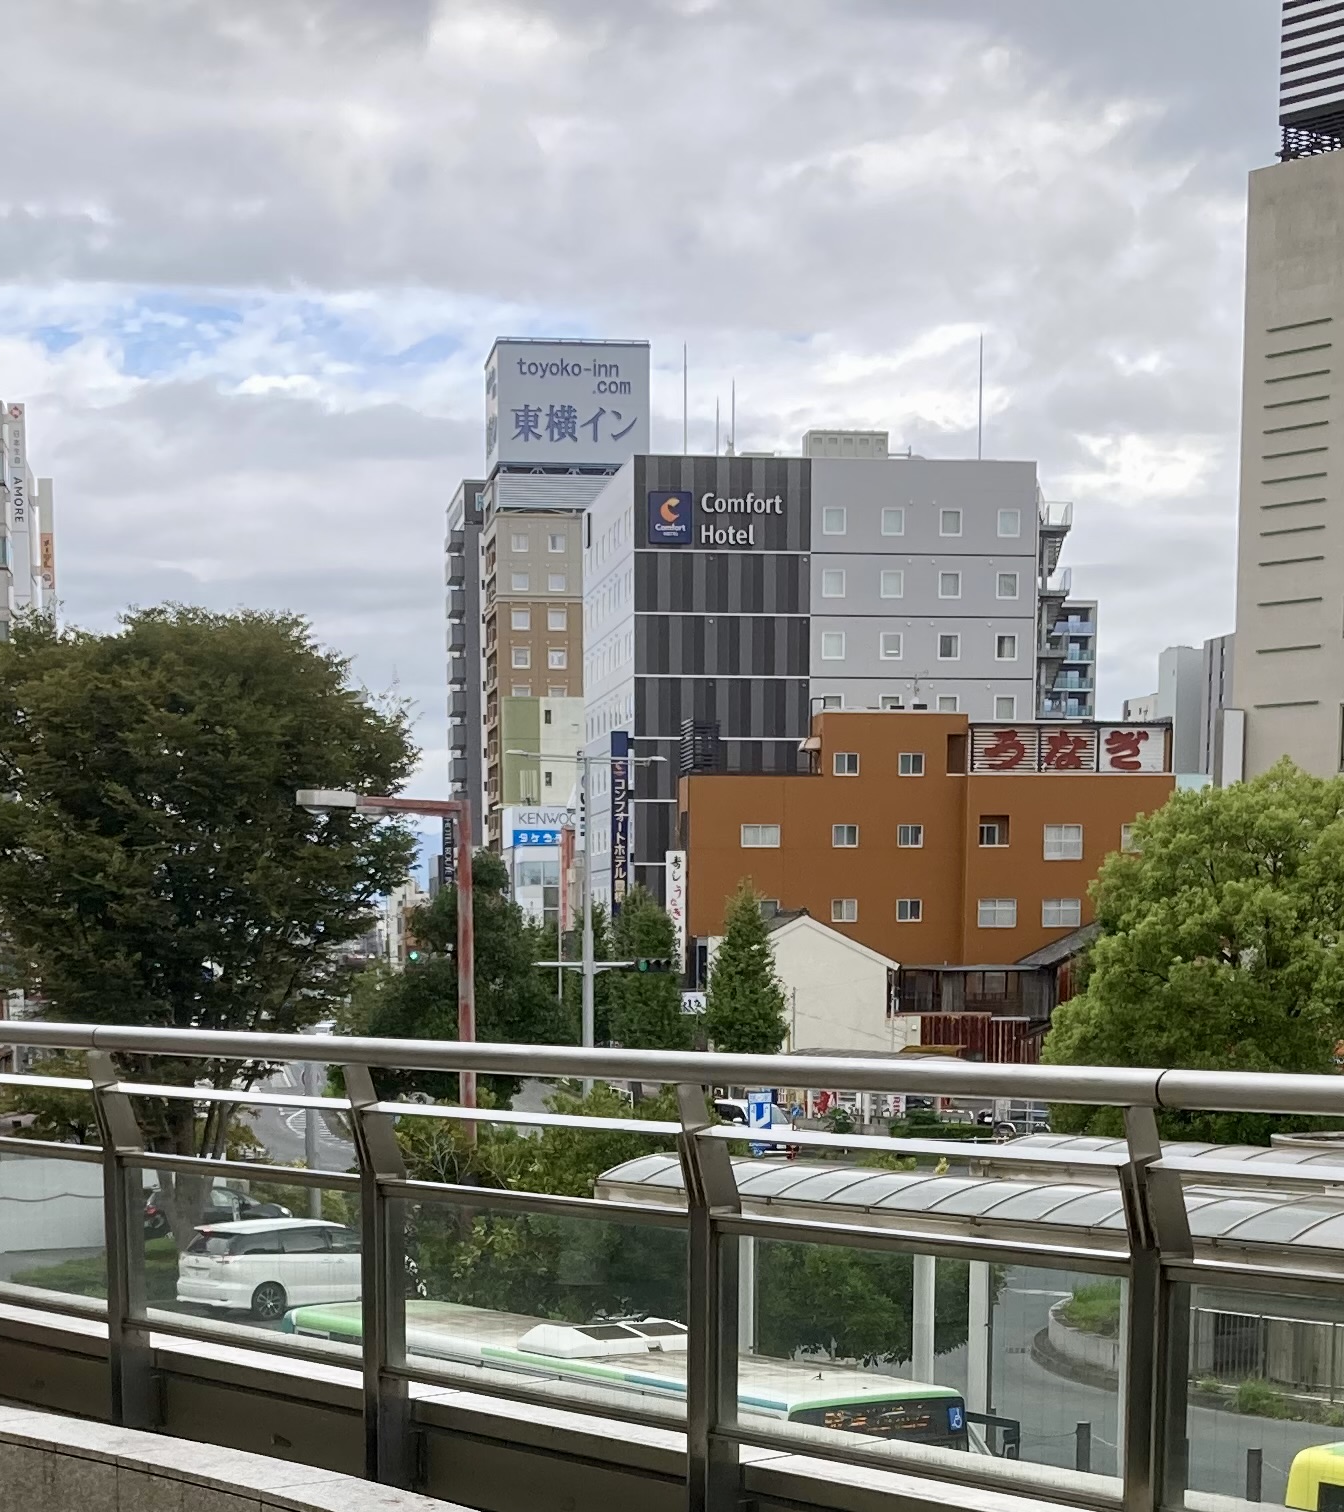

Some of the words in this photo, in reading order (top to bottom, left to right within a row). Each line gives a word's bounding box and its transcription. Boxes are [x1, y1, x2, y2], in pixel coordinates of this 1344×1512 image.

[516, 357, 620, 378] toyoko-inn
[592, 380, 632, 395] .com
[510, 403, 638, 443] 東横イン
[13, 476, 25, 523] AMORE
[701, 491, 784, 515] Comfort
[700, 523, 756, 545] Hotel
[983, 729, 1150, 771] うなぎ
